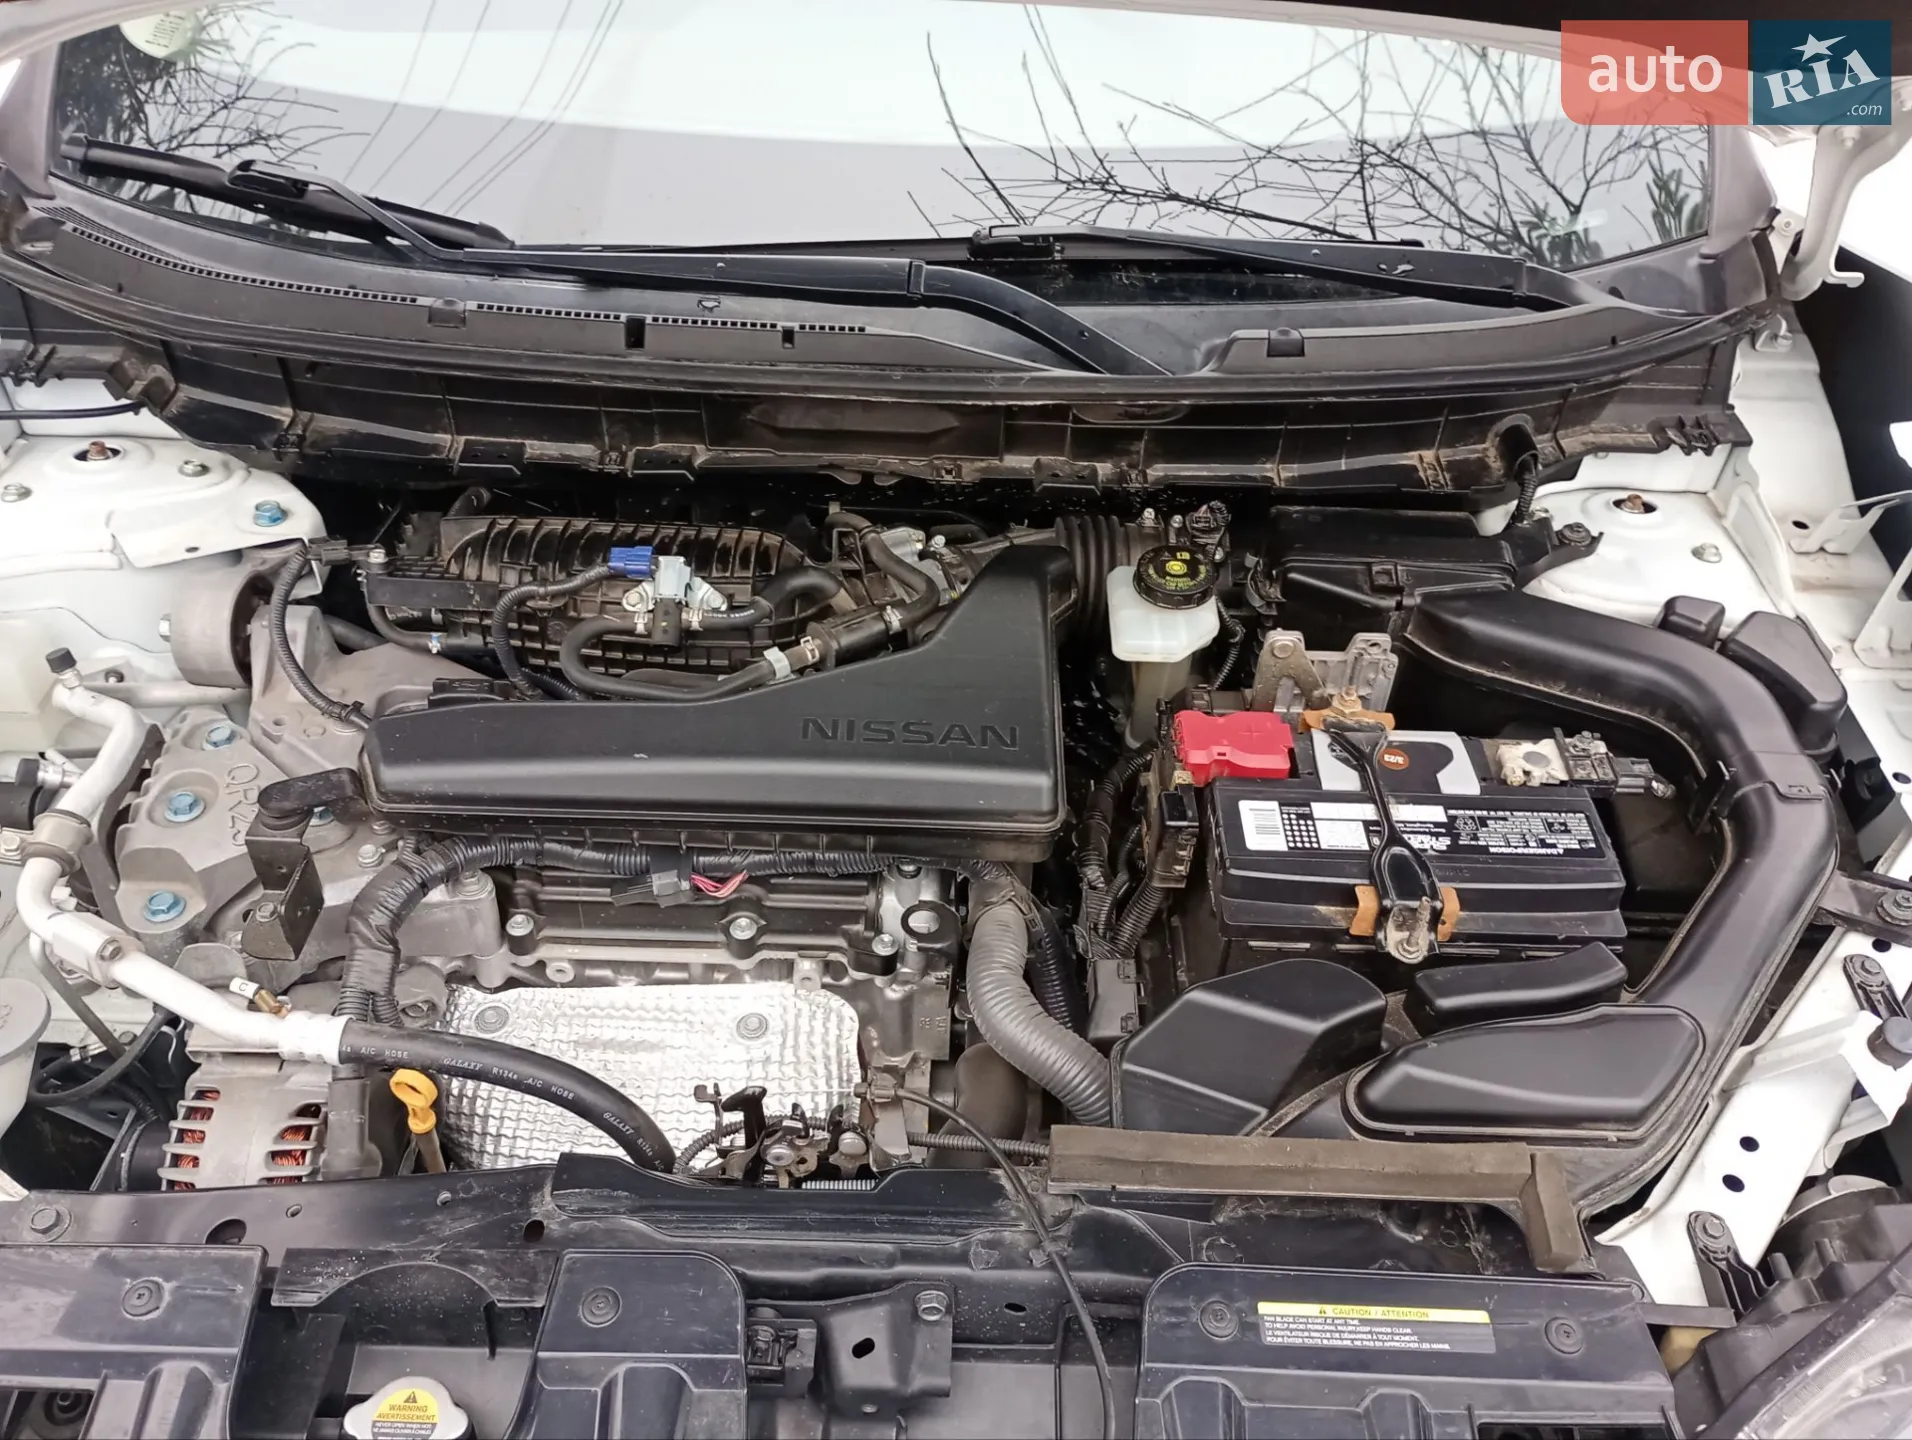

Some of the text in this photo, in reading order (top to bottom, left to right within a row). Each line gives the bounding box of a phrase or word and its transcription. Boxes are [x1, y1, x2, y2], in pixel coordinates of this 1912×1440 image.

[801, 717, 1019, 750] NISSAN
[360, 1046, 376, 1055] A/C
[385, 1049, 409, 1059] HOSE
[443, 1057, 483, 1071] GALAXY
[551, 1085, 575, 1100] HOSE
[603, 1112, 635, 1135] GALAXY
[1332, 1307, 1371, 1316] CAUTION
[1381, 1309, 1429, 1319] ATTENTION
[389, 1404, 428, 1413] WARNING
[376, 1412, 436, 1421] AVERTISSEMENT
